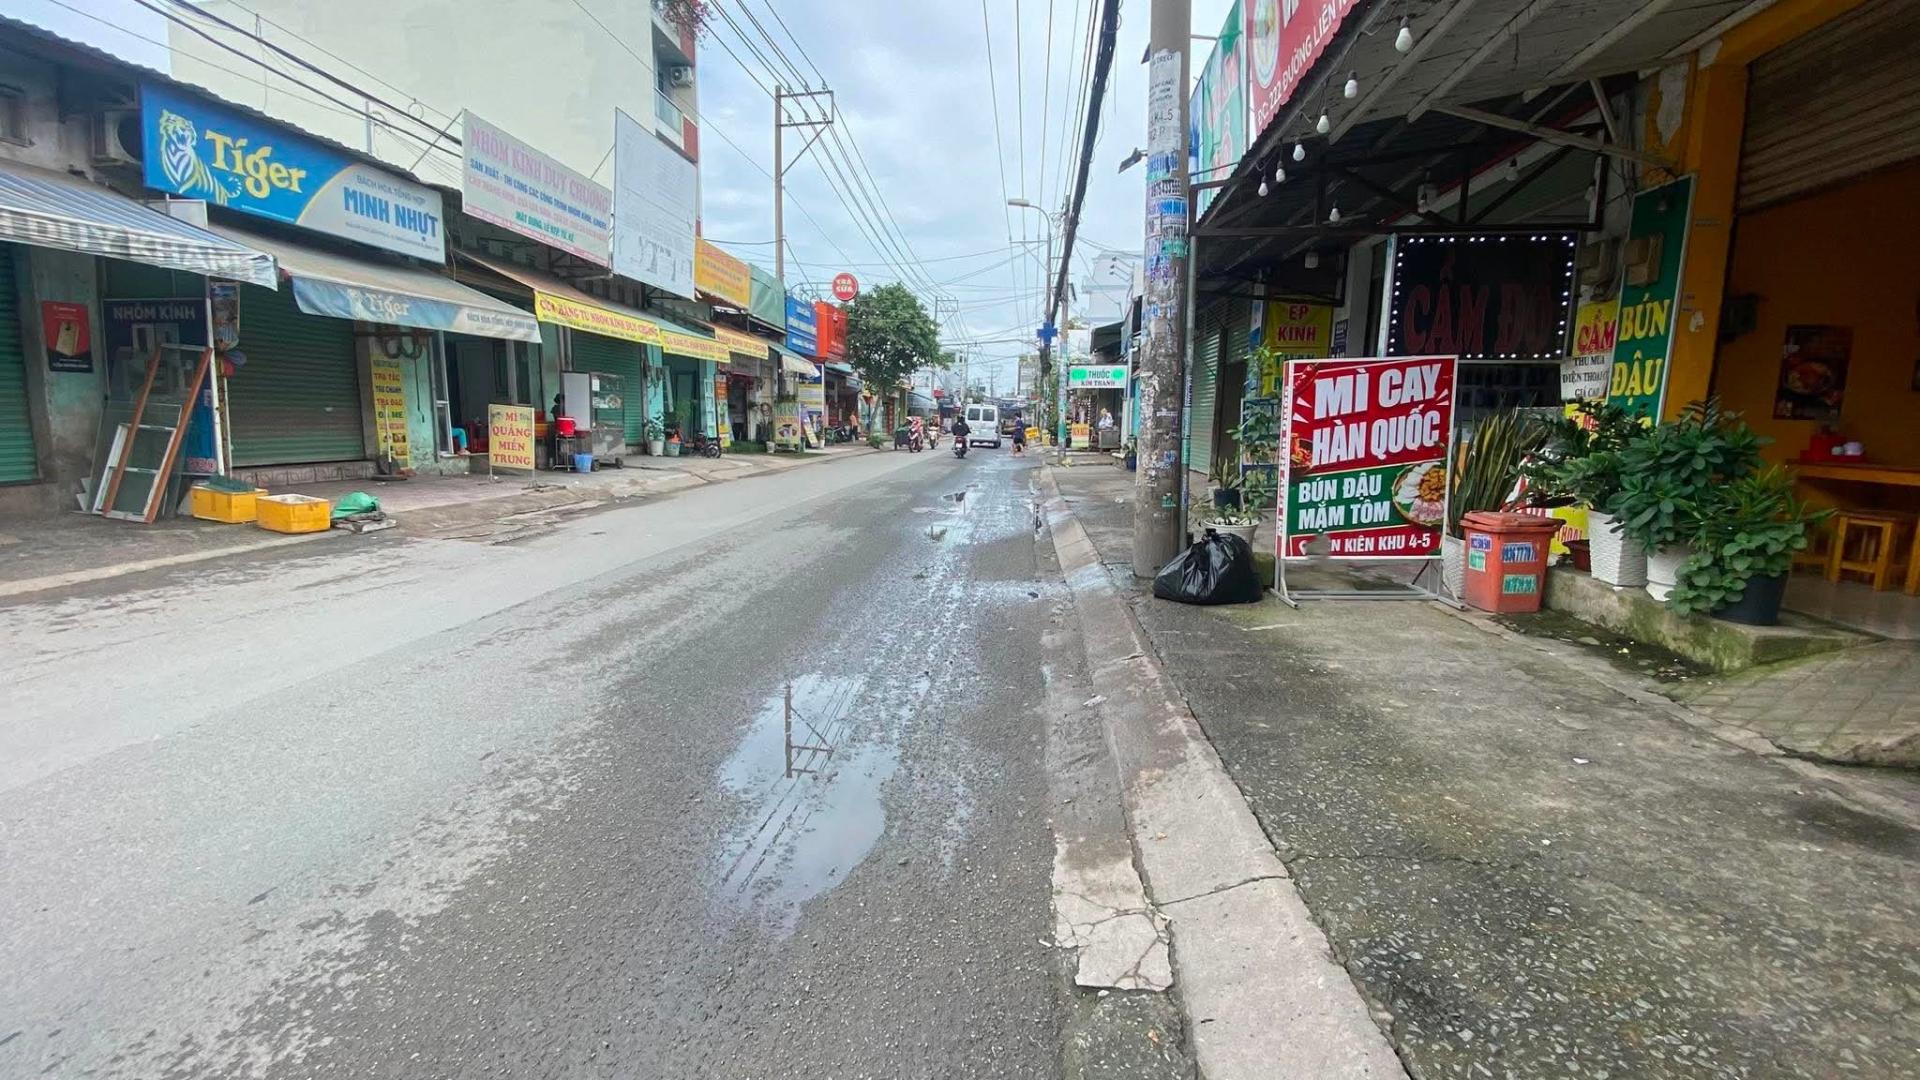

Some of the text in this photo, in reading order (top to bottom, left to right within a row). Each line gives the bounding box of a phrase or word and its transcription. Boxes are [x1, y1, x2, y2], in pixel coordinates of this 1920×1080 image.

[1269, 82, 1282, 107] 222
[1281, 35, 1313, 91] ĐƯỜNG
[1313, 6, 1337, 46] LIÊN
[205, 129, 307, 199] Tiger
[471, 125, 509, 164] NHÔM
[543, 164, 568, 193] DUY
[343, 186, 390, 224] MINH
[394, 203, 439, 242] NHỰT
[113, 303, 196, 320] NHÔM KÍNH
[367, 294, 410, 320] Tiger
[1619, 293, 1671, 341] BÚN
[1574, 356, 1605, 367] THU MUA
[1314, 363, 1442, 420] MÌ CAY
[1562, 372, 1582, 383] ĐIỆN
[1575, 387, 1587, 398] GIÁ
[1611, 350, 1663, 406] ĐẬU
[1311, 404, 1441, 466] HÀN QUỐC
[493, 453, 531, 466] TRUNG
[1298, 472, 1382, 503] BÚN ĐẬU
[1350, 499, 1391, 525] TÔM
[1344, 535, 1375, 553] KIÊN
[1378, 535, 1405, 551] KHU
[1408, 533, 1431, 549] 4-5
